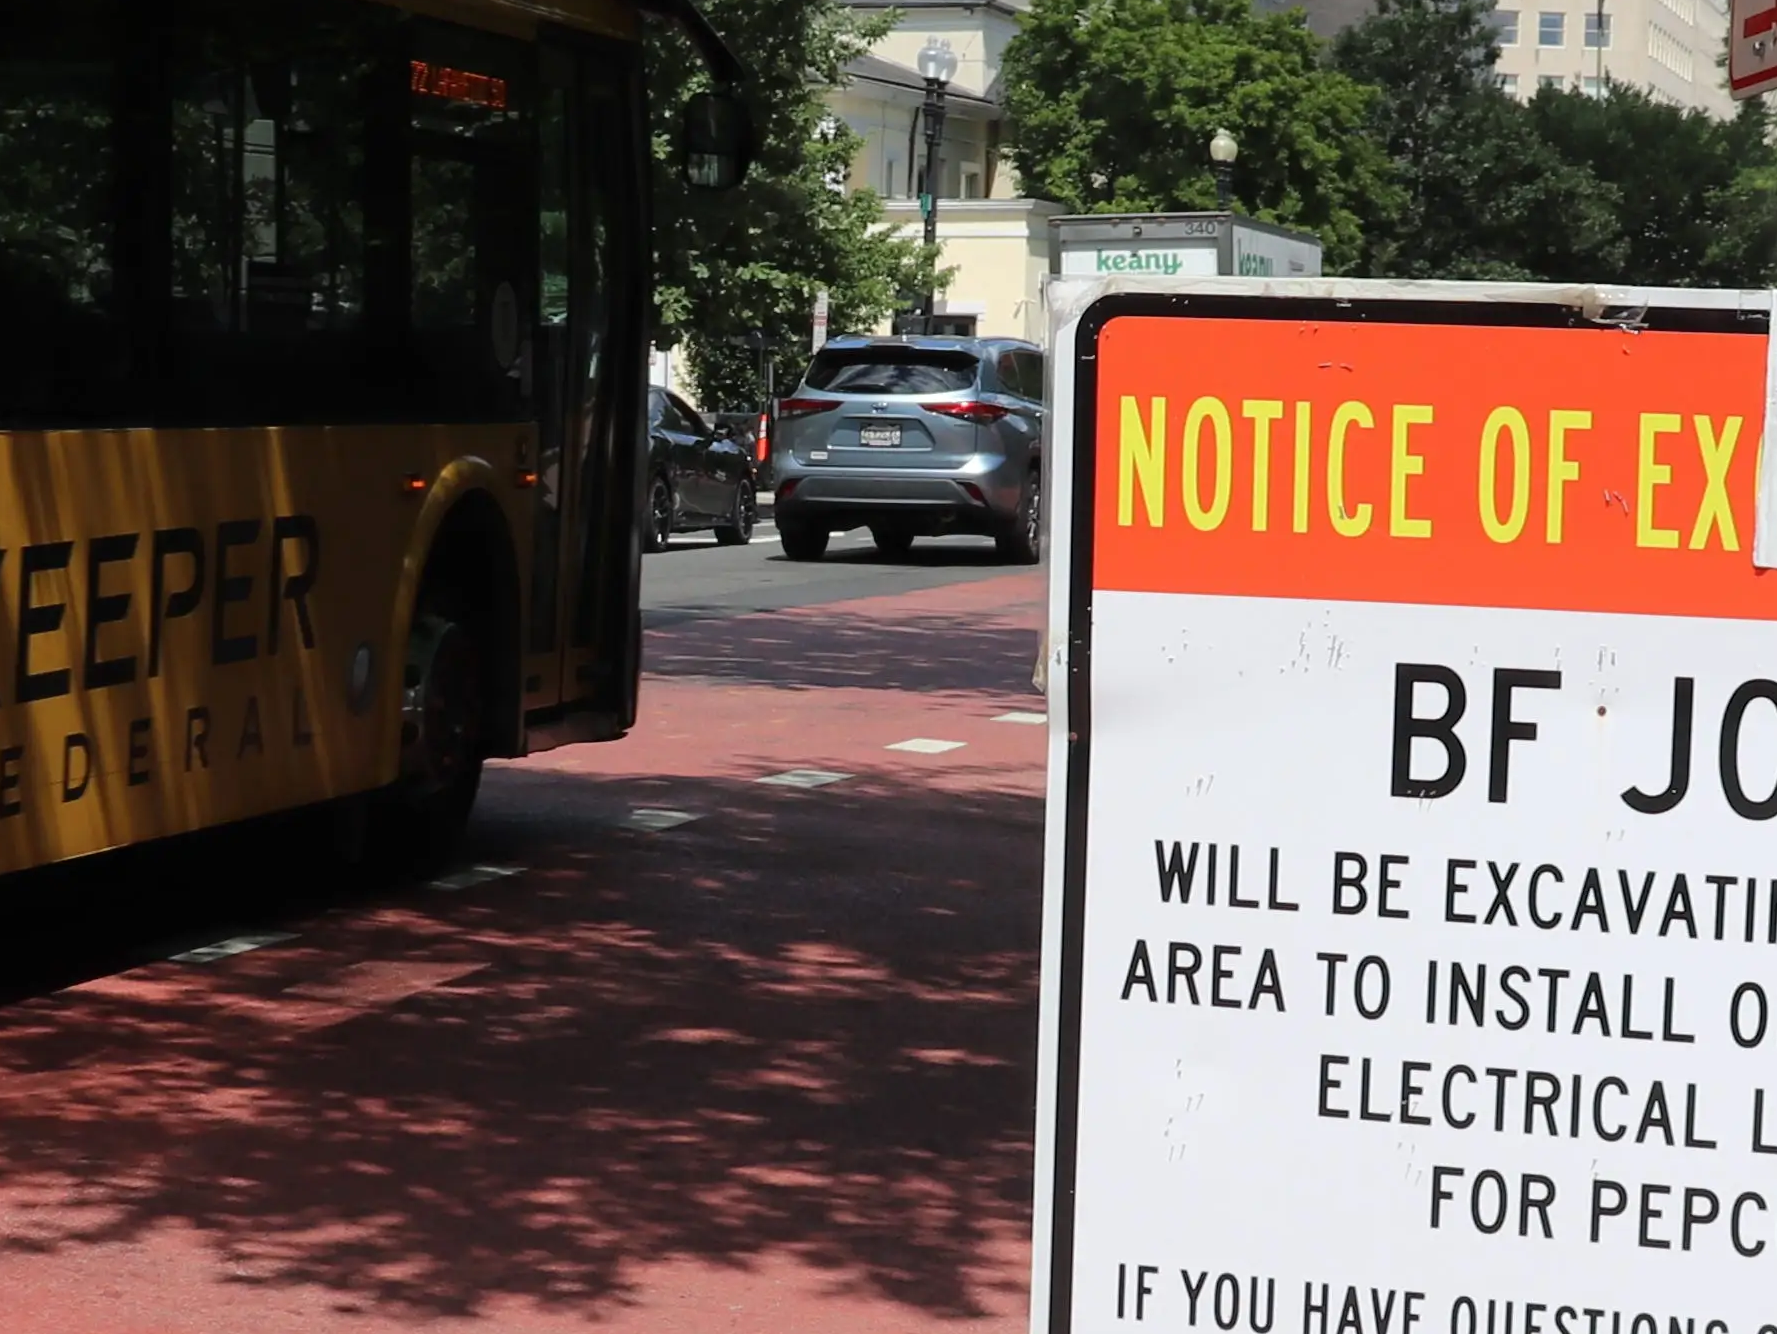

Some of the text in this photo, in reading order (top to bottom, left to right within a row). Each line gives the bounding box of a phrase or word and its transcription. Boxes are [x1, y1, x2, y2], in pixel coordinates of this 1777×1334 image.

[1096, 247, 1183, 275] keany
[1184, 222, 1216, 235] 340
[1116, 395, 1433, 539] NOTICE
[1476, 406, 1584, 545] OF
[1390, 662, 1562, 804] BF
[1154, 839, 1299, 912] WILL
[1332, 851, 1410, 919] BE
[1120, 939, 1286, 1012] AREA
[1316, 952, 1391, 1020] TO
[1426, 960, 1695, 1043] INSTALL
[1318, 1054, 1717, 1150] ELECTRICAL
[1430, 1165, 1556, 1239] FOR
[1117, 1263, 1159, 1321] IF
[1180, 1269, 1275, 1334] YOU
